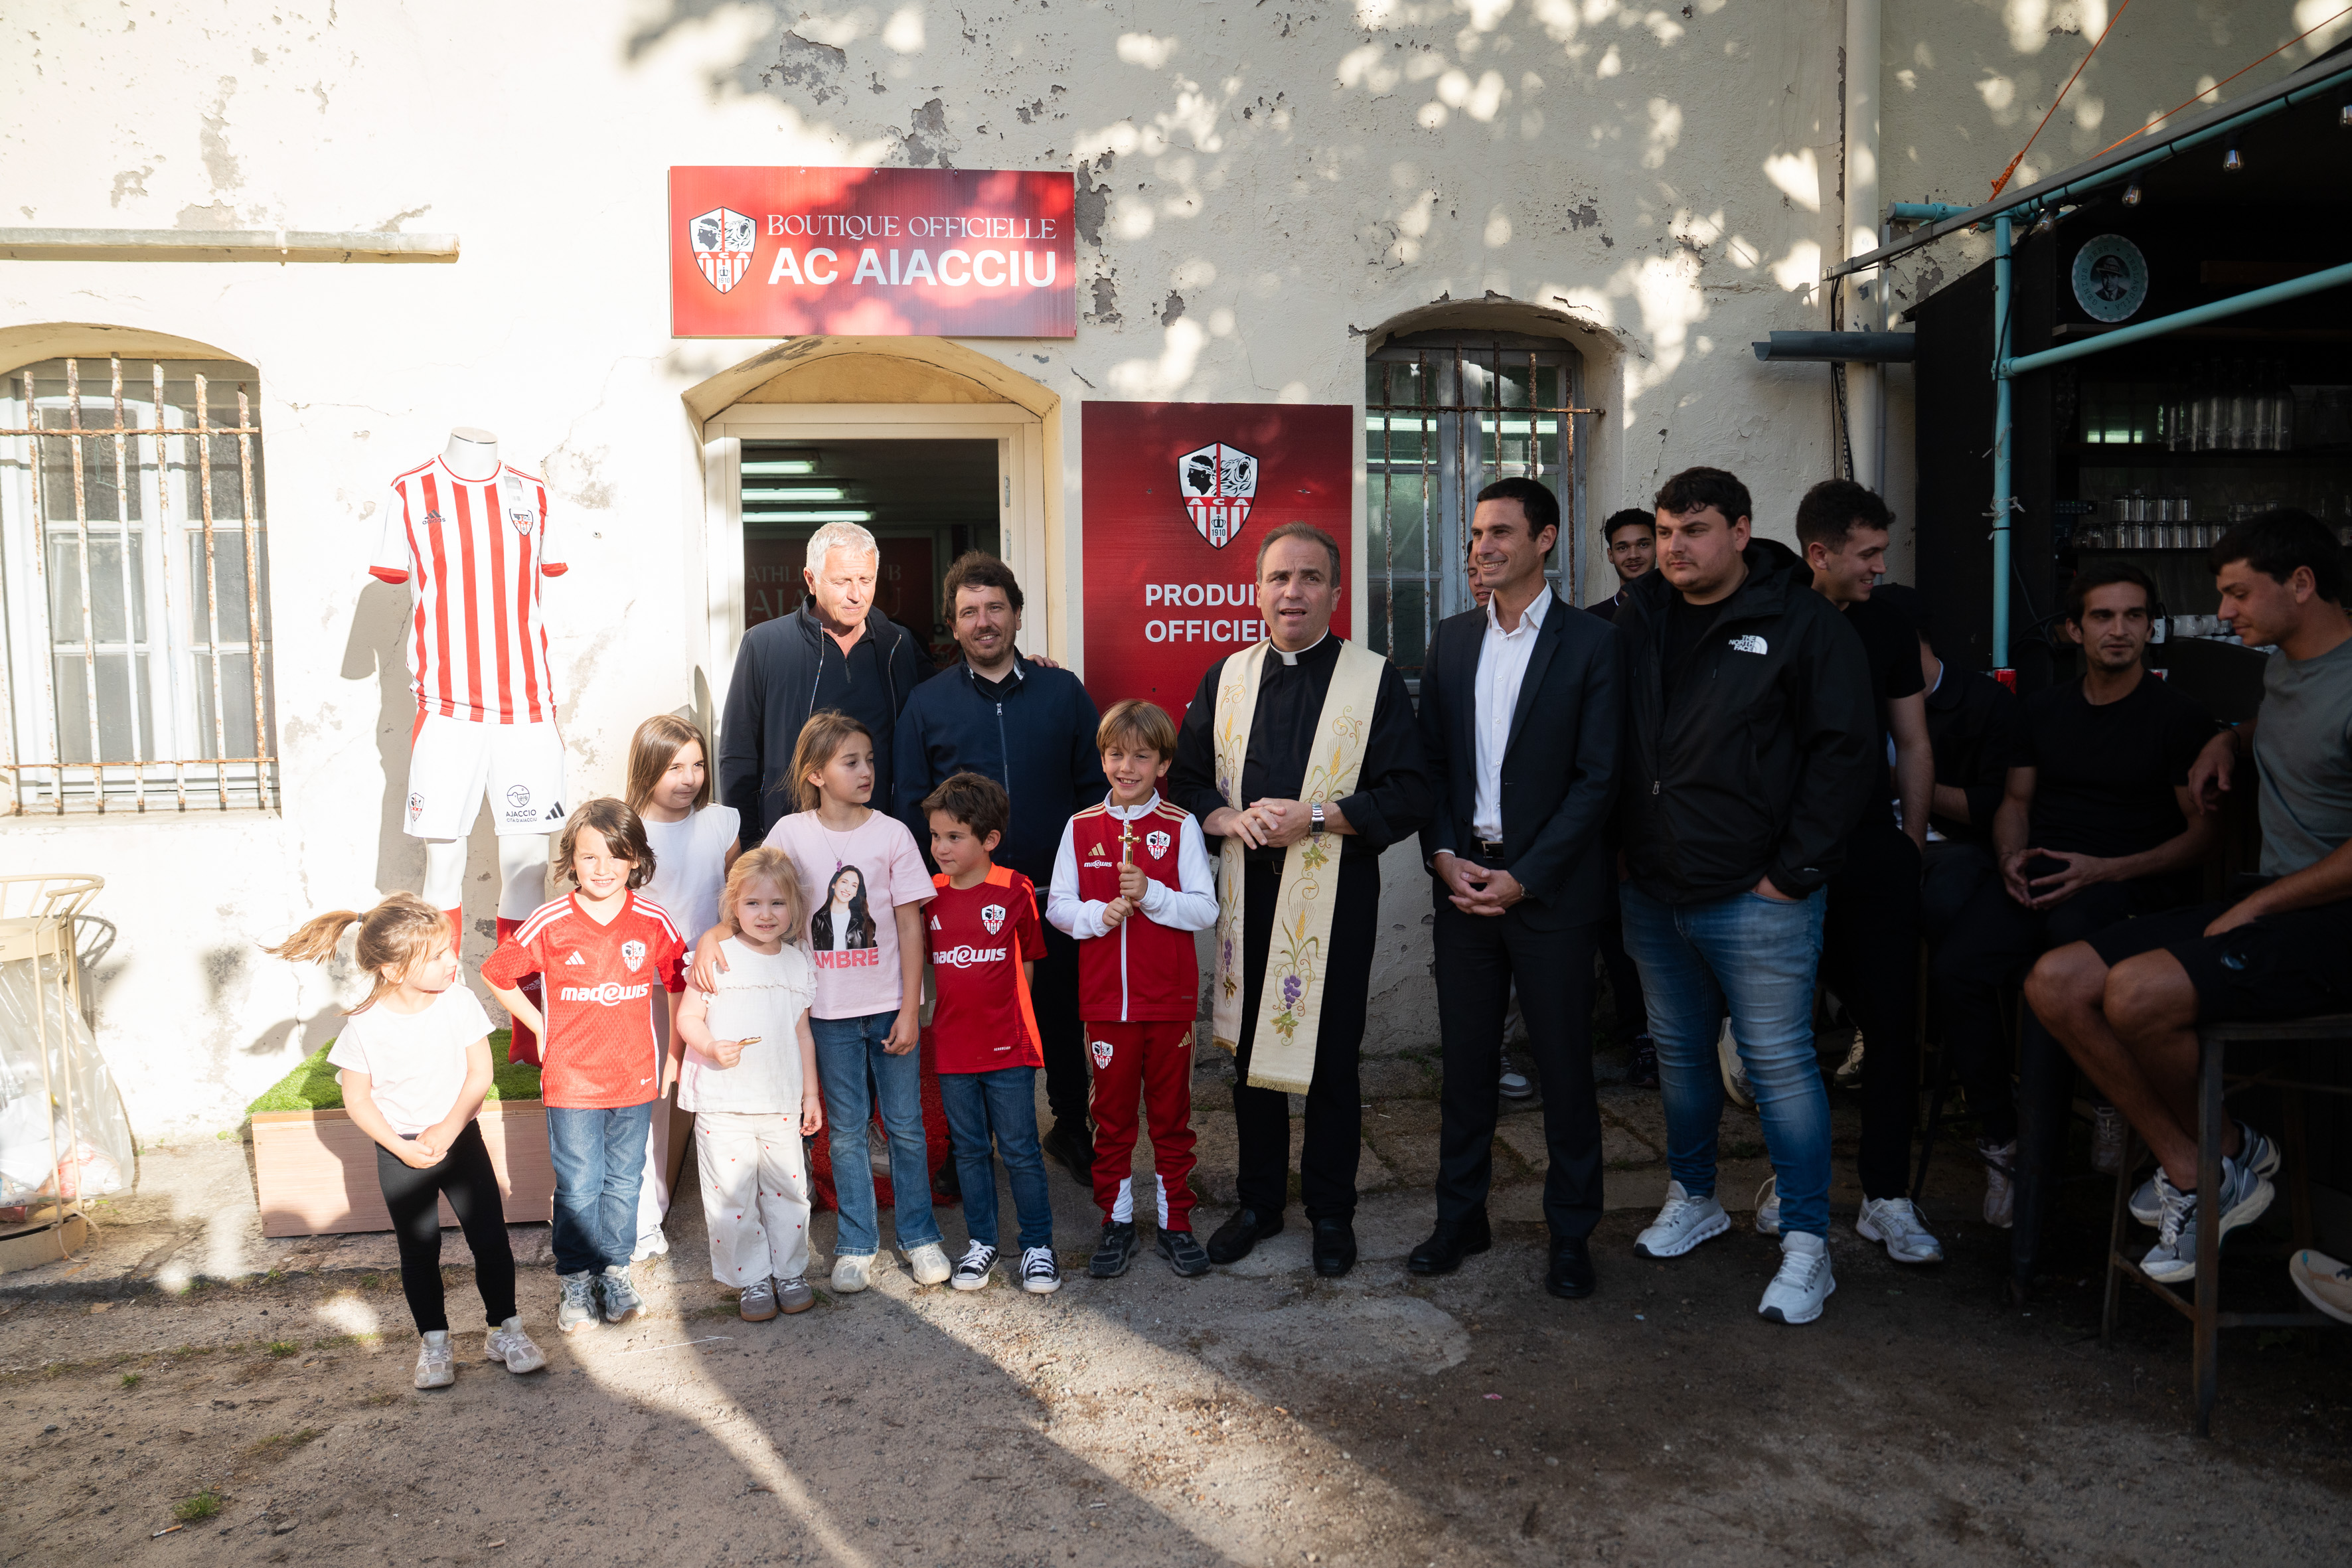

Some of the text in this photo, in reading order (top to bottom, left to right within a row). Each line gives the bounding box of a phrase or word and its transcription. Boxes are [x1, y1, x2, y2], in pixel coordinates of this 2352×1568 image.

[767, 214, 1057, 240] BOUTIQUE OFFICIELLE
[767, 248, 1056, 287] AC AIACCIU
[2082, 245, 2110, 305] GENIUS BEER
[2115, 253, 2140, 310] TESLAQUILA
[1146, 584, 1255, 606] PRODUI
[1145, 619, 1271, 643] OFFICIEL
